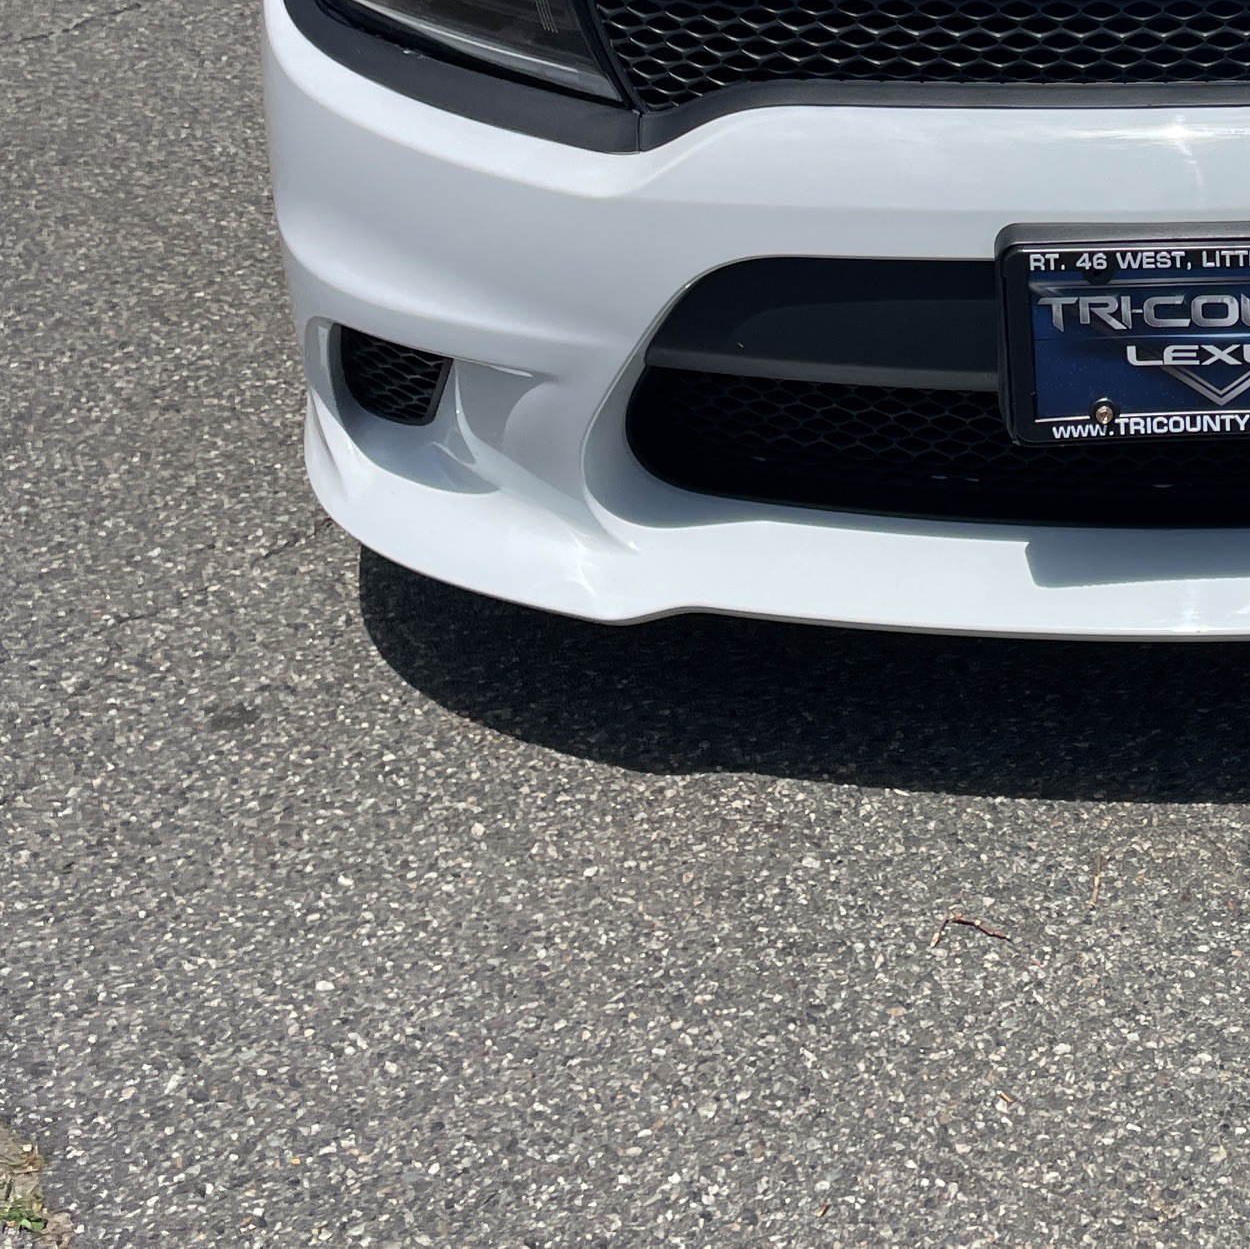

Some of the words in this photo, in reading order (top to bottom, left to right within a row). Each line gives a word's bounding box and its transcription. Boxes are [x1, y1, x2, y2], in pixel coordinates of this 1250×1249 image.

[1029, 253, 1066, 271] RT.
[1075, 252, 1108, 270] 46
[1115, 251, 1192, 270] WEST,
